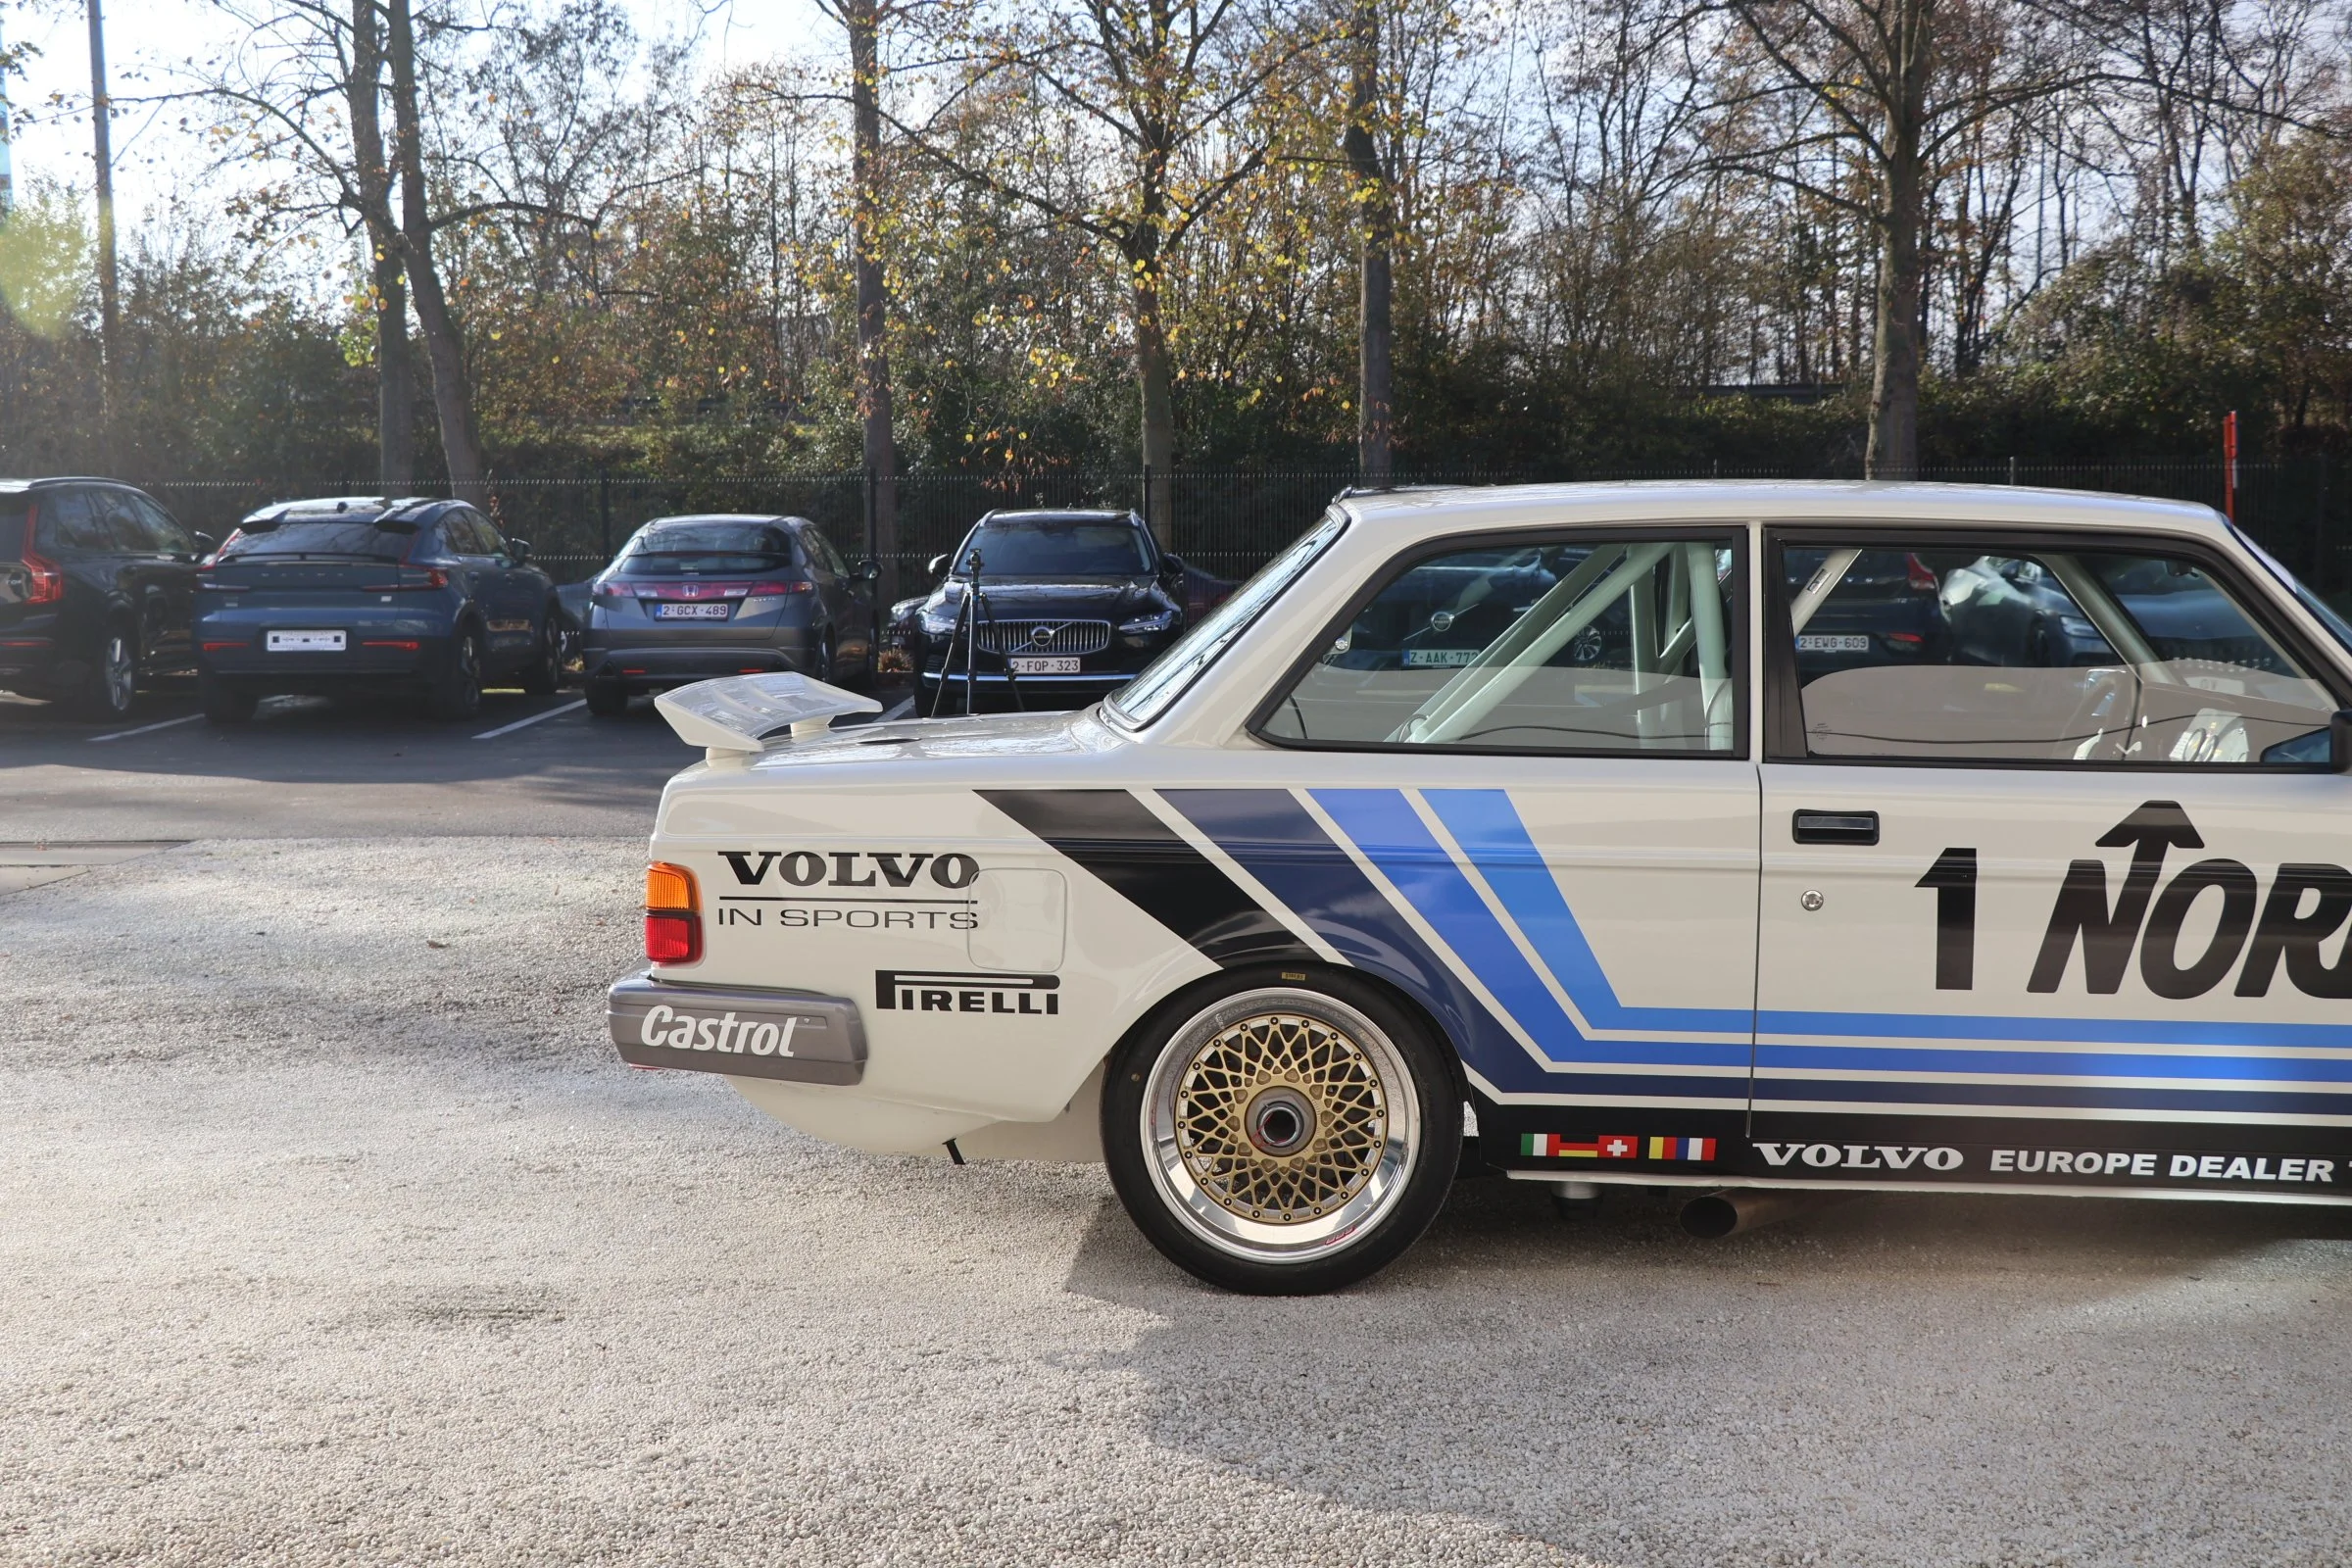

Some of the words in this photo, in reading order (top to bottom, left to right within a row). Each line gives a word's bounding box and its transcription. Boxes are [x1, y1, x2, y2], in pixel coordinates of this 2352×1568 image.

[717, 851, 979, 889] VOLVO
[718, 907, 762, 926] IN
[780, 908, 979, 930] SPORTS
[1915, 848, 1977, 990] 1
[2027, 801, 2352, 1000] NOR
[875, 970, 1060, 1014] PIRELLI
[641, 1004, 798, 1057] Castrol
[1752, 1143, 1964, 1171] VOLVO
[1989, 1150, 2158, 1176] EUROPE
[2169, 1154, 2334, 1182] DEALER
